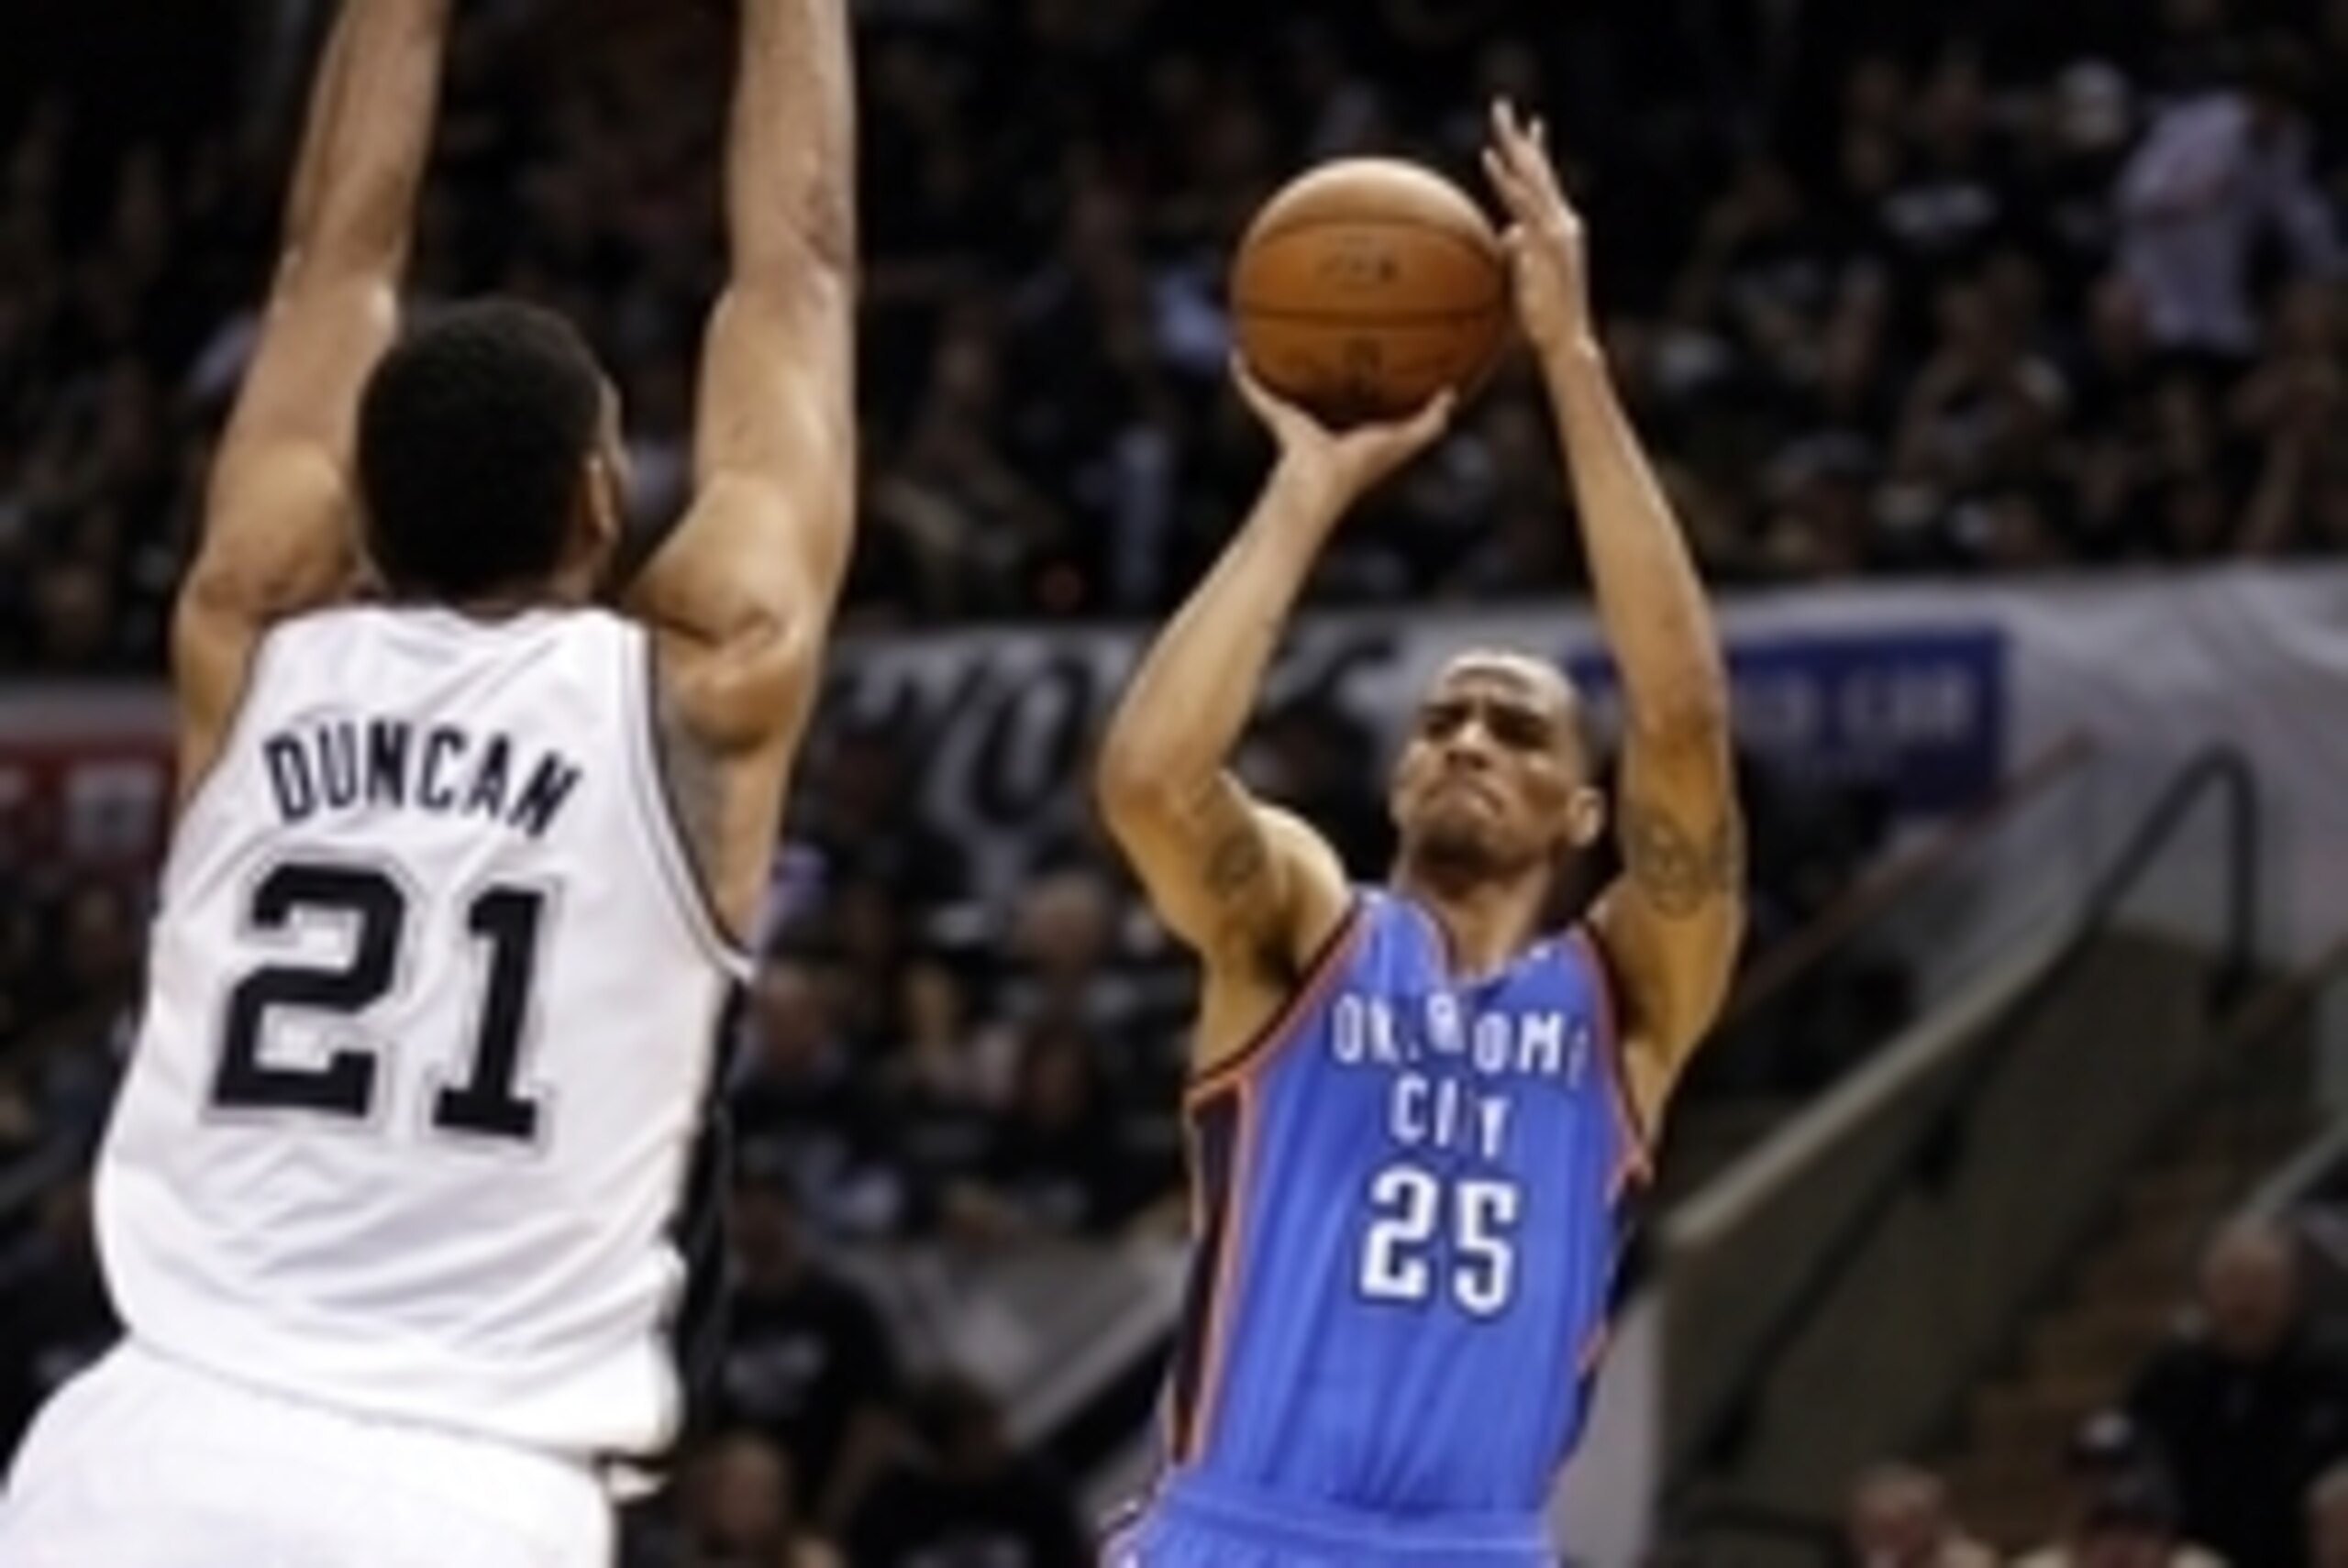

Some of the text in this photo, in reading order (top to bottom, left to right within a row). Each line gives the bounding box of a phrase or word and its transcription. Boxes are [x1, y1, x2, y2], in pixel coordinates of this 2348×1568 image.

[262, 718, 581, 837] DUNCAN
[211, 863, 547, 1141] 21
[1390, 1071, 1513, 1161] CIY
[1361, 1161, 1519, 1316] 25
